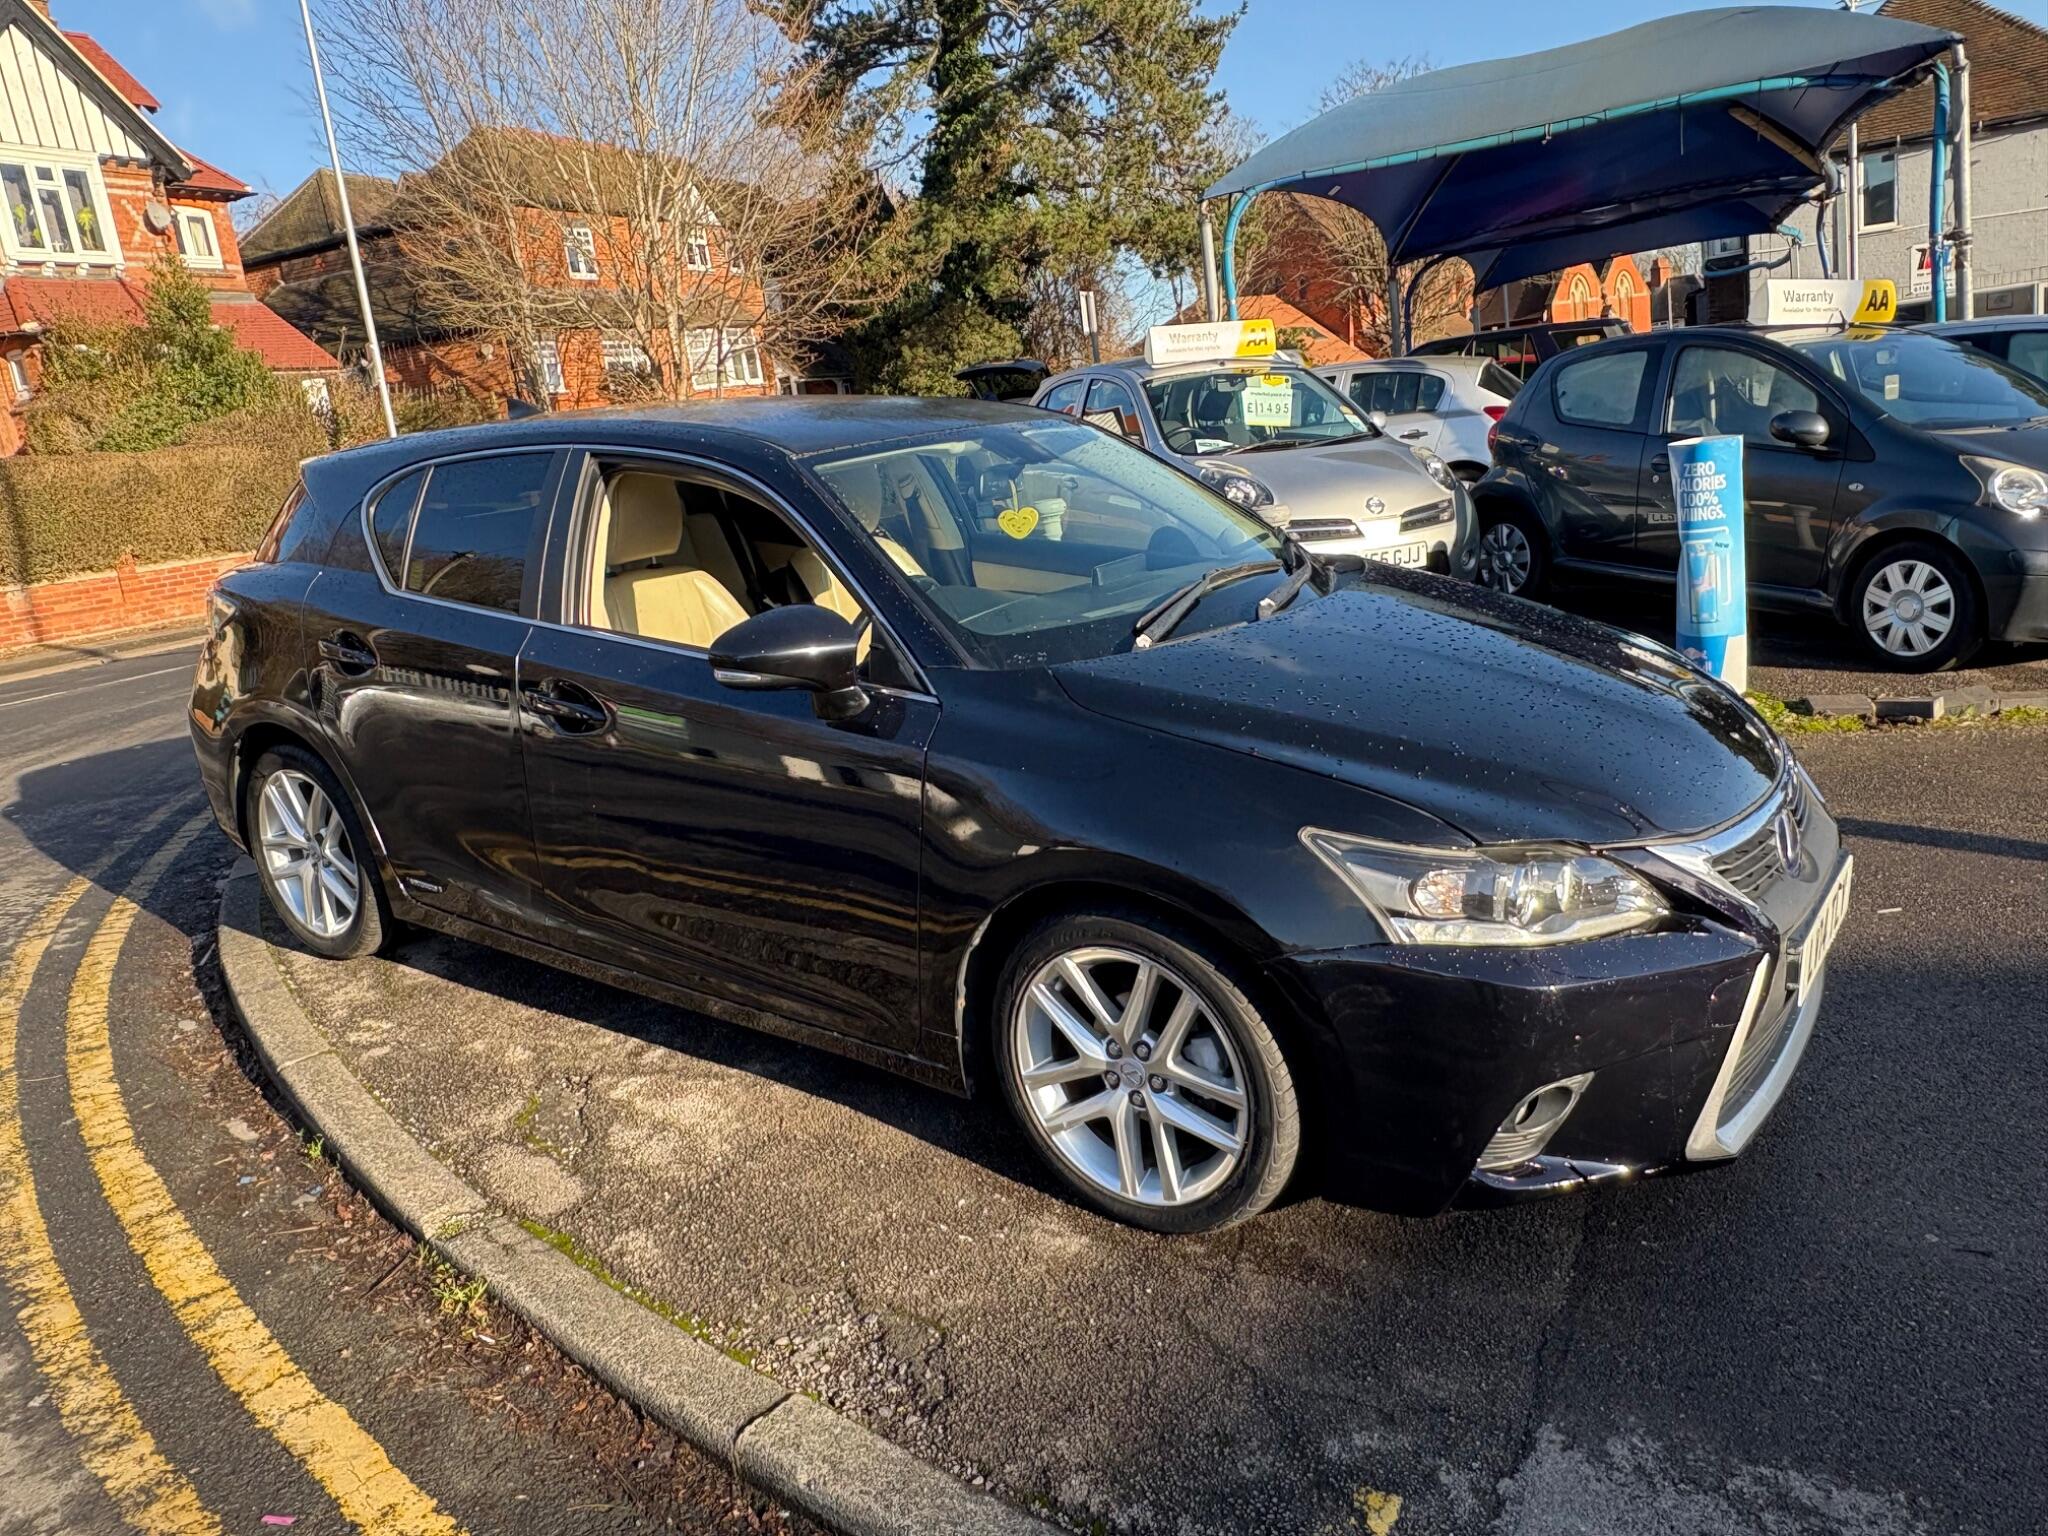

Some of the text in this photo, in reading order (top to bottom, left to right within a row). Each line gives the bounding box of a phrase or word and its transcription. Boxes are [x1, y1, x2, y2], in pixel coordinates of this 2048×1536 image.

[1782, 289, 1834, 304] Warranty
[1865, 289, 1889, 311] AA
[1168, 331, 1218, 345] Warranty
[1683, 461, 1716, 477] ZERO
[1679, 474, 1727, 492] ALORIES
[1683, 490, 1719, 507] 100%
[1394, 545, 1420, 566] GJJ
